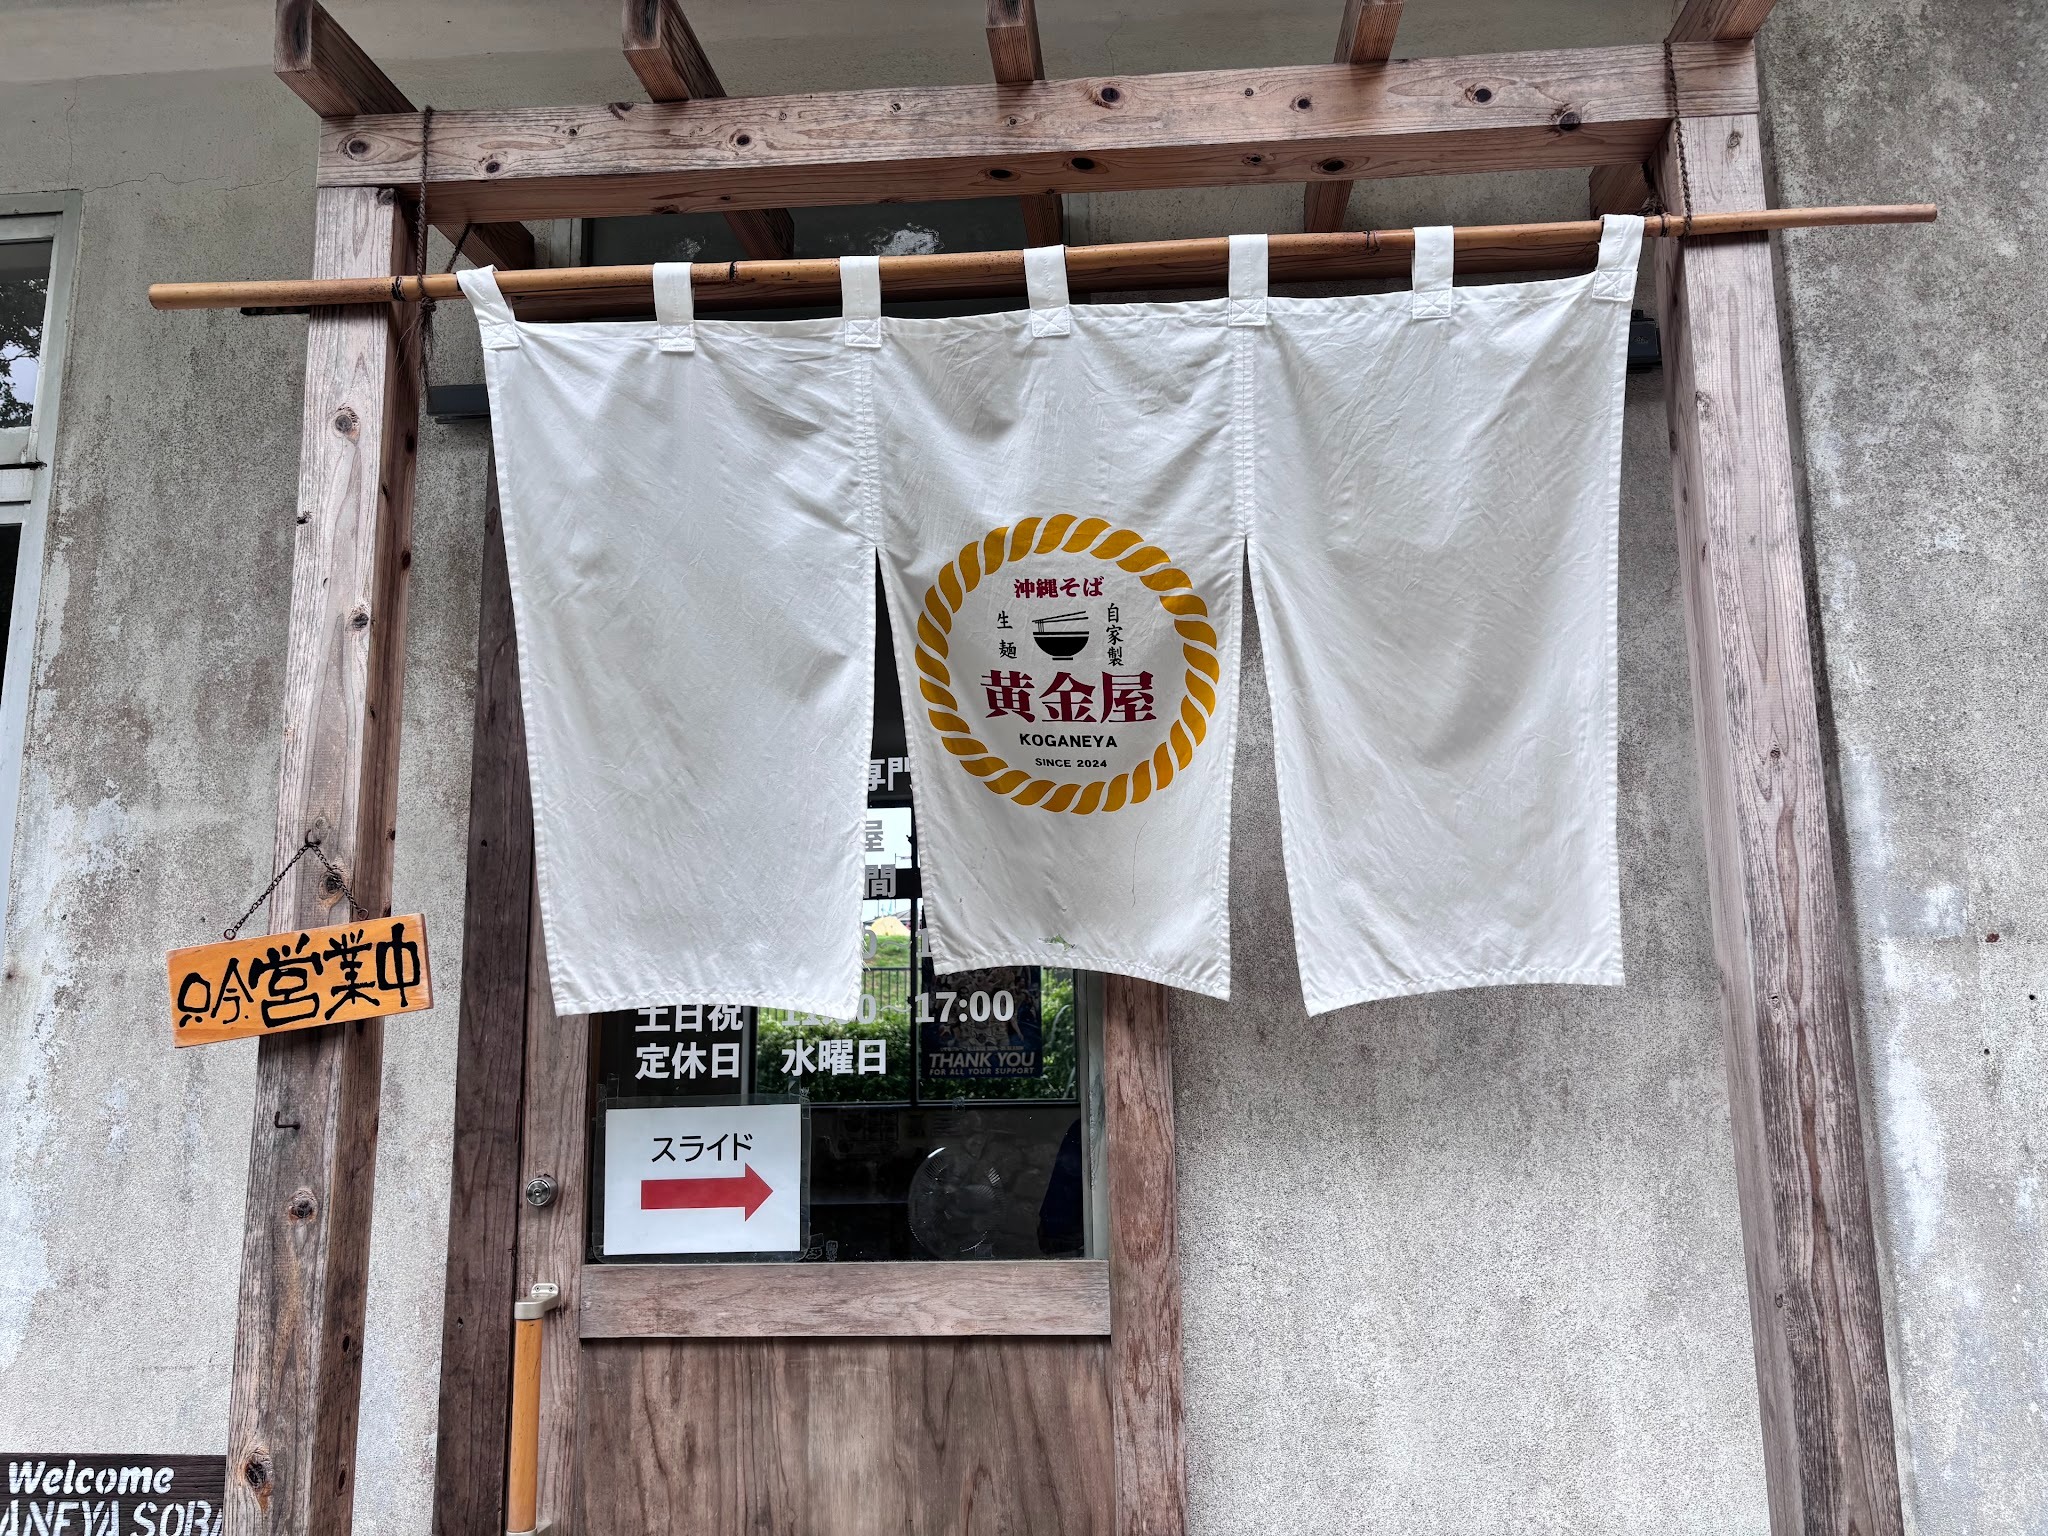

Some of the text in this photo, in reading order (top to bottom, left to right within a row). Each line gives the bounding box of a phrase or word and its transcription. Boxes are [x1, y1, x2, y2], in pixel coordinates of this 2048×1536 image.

[1014, 577, 1105, 599] 沖縄そば
[997, 610, 1018, 660] 生麺
[1106, 603, 1124, 666] 自家製
[980, 669, 1157, 724] 黄金屋
[1019, 733, 1118, 748] KOGANEYA
[1035, 758, 1107, 768] SINCE 2024
[635, 1038, 887, 1080] 定休日 水曜日
[929, 1051, 1035, 1069] THANK YOU
[929, 1067, 1035, 1076] FOR ALL YOUR SUPPORT
[651, 1133, 753, 1163] スライド
[8, 1459, 175, 1495] Welcome
